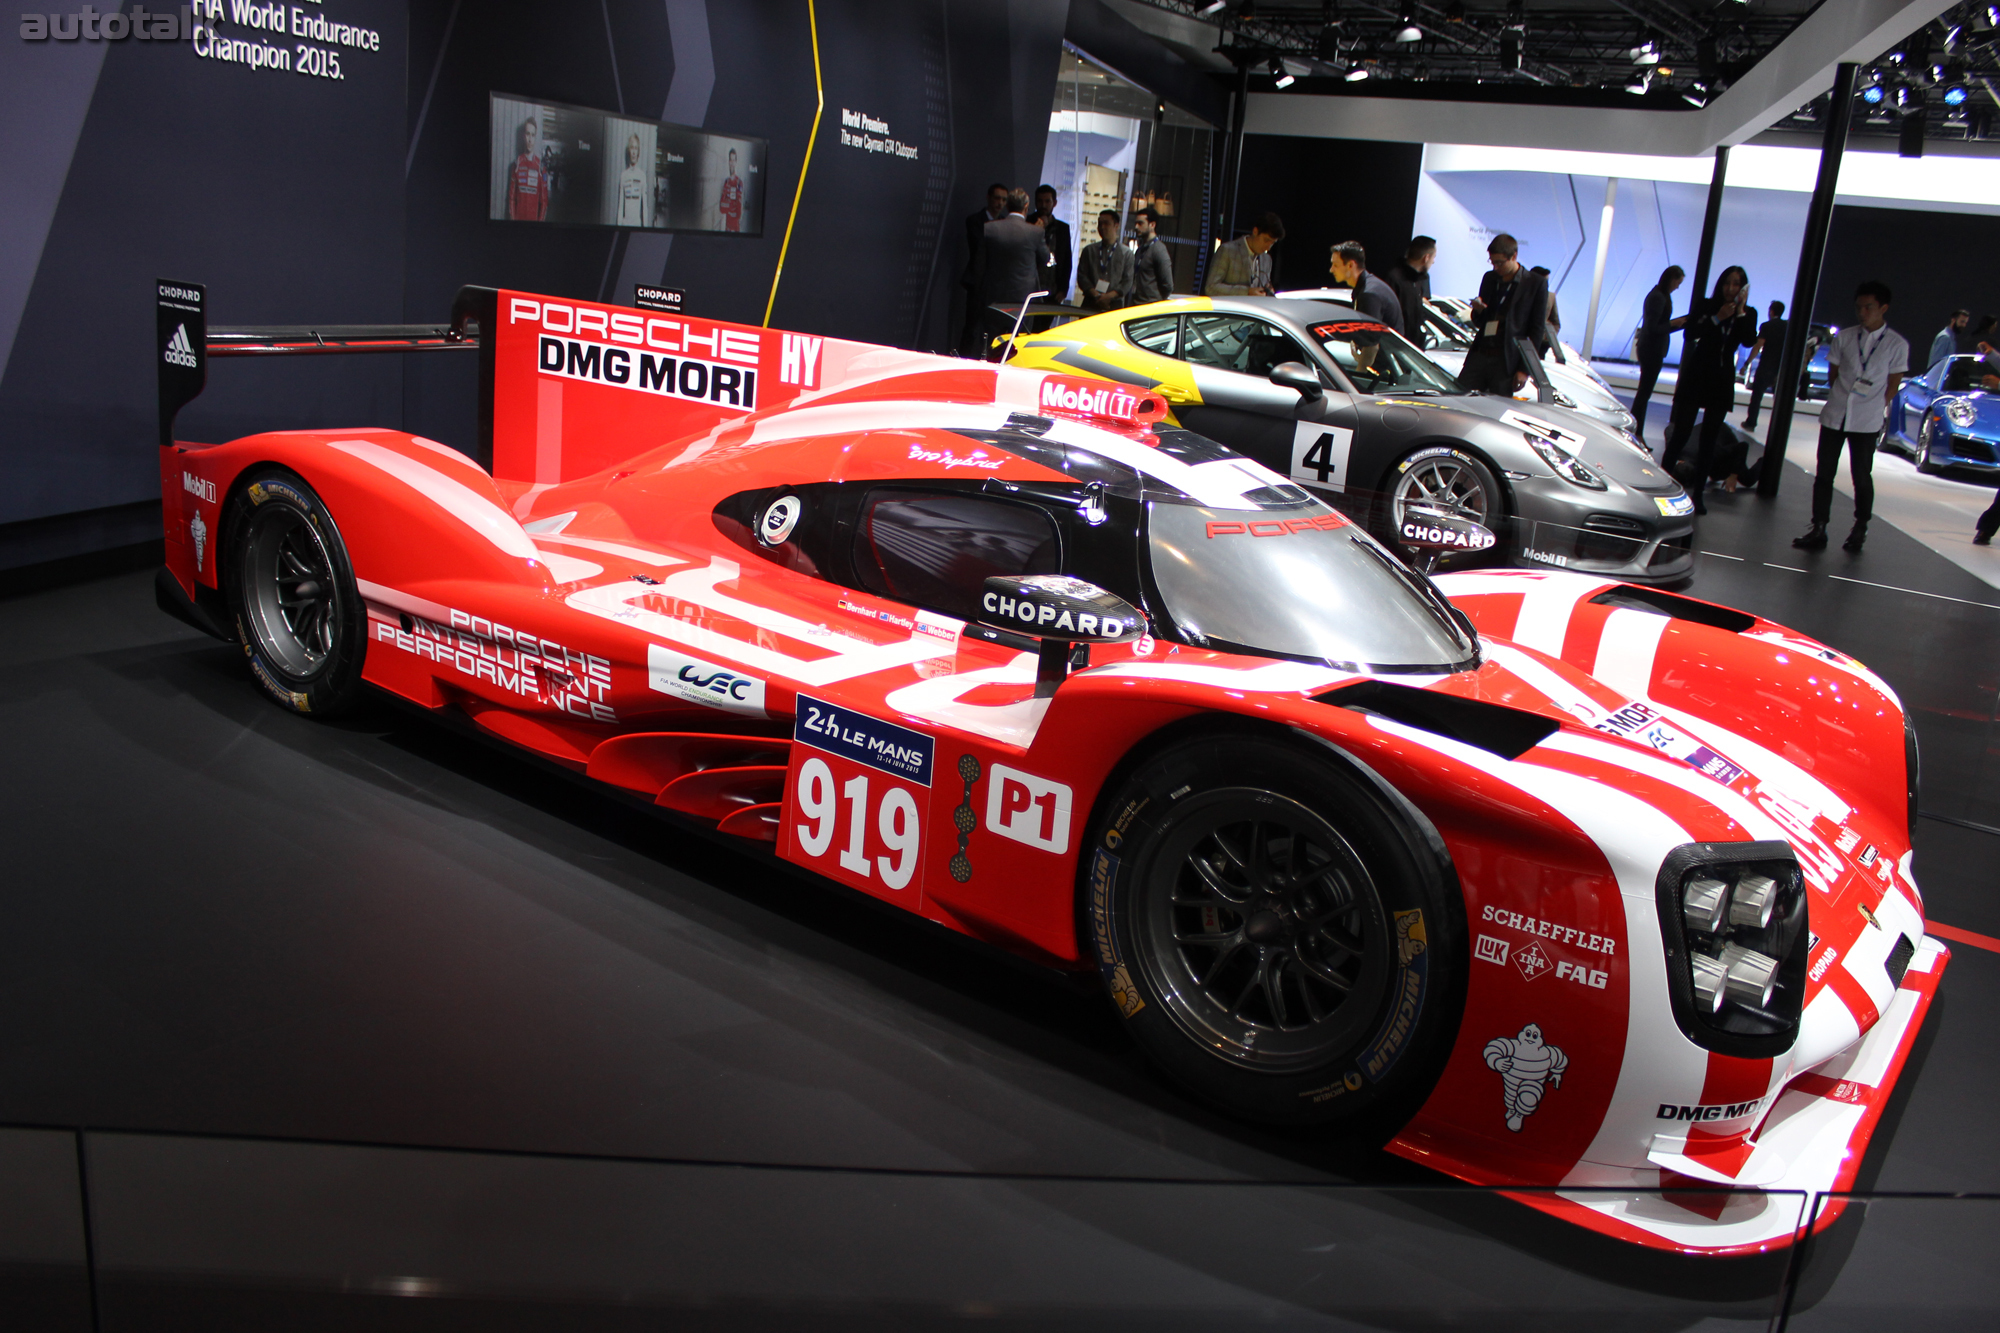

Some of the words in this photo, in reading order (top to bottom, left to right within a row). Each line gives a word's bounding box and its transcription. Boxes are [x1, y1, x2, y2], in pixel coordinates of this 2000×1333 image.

[192, 0, 225, 21] FIA
[230, 0, 285, 33] World
[291, 7, 379, 51] Endurance
[193, 25, 290, 71] Champion
[296, 44, 344, 80] 2015.
[842, 107, 861, 129] World
[861, 113, 890, 136] Premiere.
[841, 128, 851, 146] The
[852, 134, 863, 148] new
[864, 133, 884, 153] Cayman
[885, 138, 895, 154] GT4
[159, 285, 200, 302] CHOPARD
[637, 288, 681, 303] CHOPARD
[510, 298, 760, 364] PORSCHE
[165, 349, 197, 368] adidas
[540, 336, 631, 385] DMG
[639, 353, 755, 409] MORI
[780, 333, 822, 387] HY
[1043, 382, 1110, 415] Mobil
[1513, 417, 1576, 442] 4
[1302, 432, 1335, 483] 4
[1410, 448, 1450, 462] MICHELIN
[183, 471, 206, 500] Mobil
[268, 484, 309, 511] MICHELIN
[1403, 524, 1496, 548] CHOPARD
[1523, 547, 1556, 564] Mobil
[847, 603, 877, 618] Bernhard
[889, 615, 914, 630] Hartley
[928, 625, 955, 641] Webber
[983, 592, 1124, 638] CHOPARD
[450, 608, 611, 680] PORSCHE
[670, 681, 688, 691] WORLD
[689, 687, 724, 703] ENDURANCE
[678, 665, 752, 700] WEC
[681, 691, 722, 707] CHAMPIONSHIP
[843, 728, 866, 747] LE
[868, 737, 923, 766] MANS
[905, 765, 920, 774] 2015
[797, 758, 920, 890] 919
[1000, 777, 1057, 842] P1
[1115, 799, 1138, 829] MICHELIN
[1095, 854, 1115, 964] MICHELIN
[1482, 905, 1616, 955] SCHAEFFLER
[1519, 953, 1545, 968] INA
[1556, 961, 1609, 990] FAG
[1808, 947, 1837, 981] CHOPARD
[1367, 969, 1420, 1076] MICHELIN
[1656, 1103, 1722, 1121] DMG
